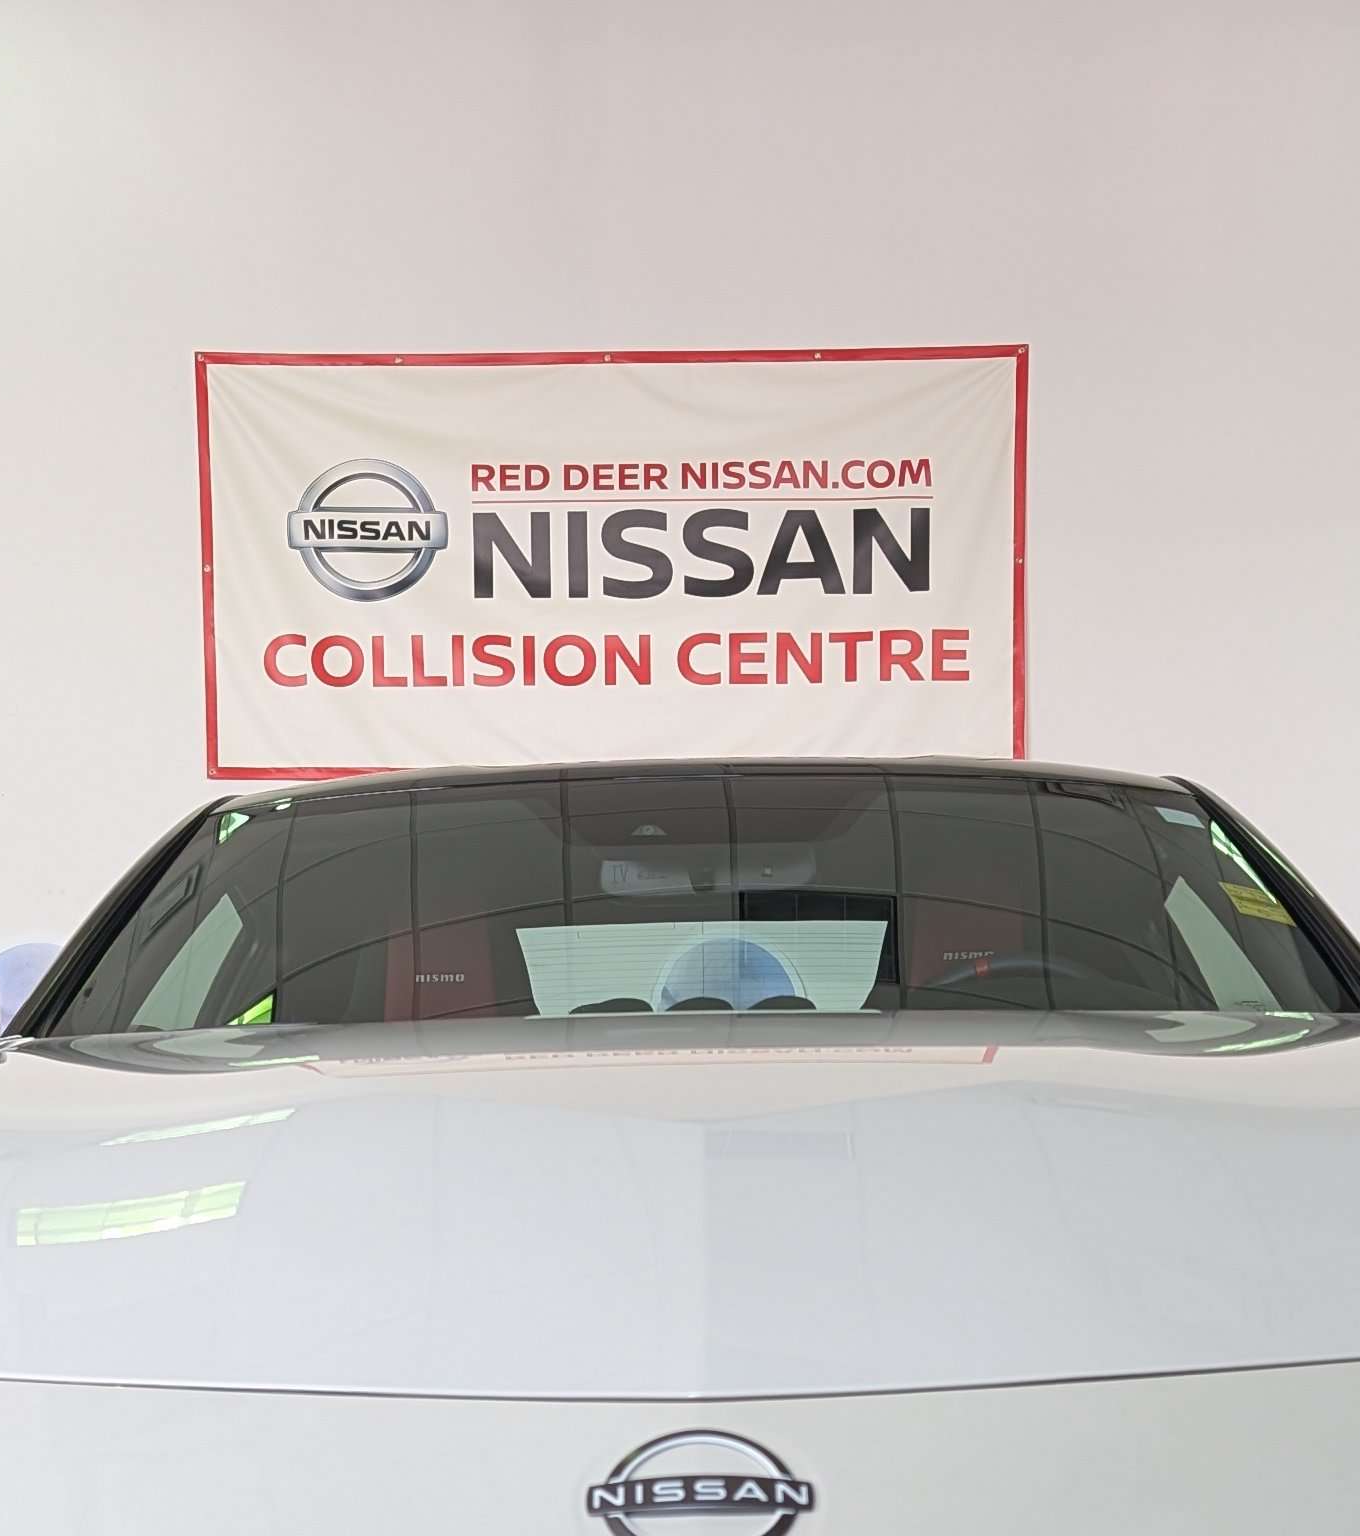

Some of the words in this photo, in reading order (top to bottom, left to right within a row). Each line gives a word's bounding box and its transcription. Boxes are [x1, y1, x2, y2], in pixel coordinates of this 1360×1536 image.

[471, 464, 551, 492] RED
[563, 463, 668, 491] DEER
[681, 458, 933, 490] NISSAN.COM
[302, 518, 432, 542] NISSAN
[472, 507, 931, 600] NISSAN
[263, 633, 652, 688] COLLISION
[677, 629, 971, 686] CENTRE
[415, 973, 465, 983] nismo
[592, 1478, 810, 1509] NISSAN
